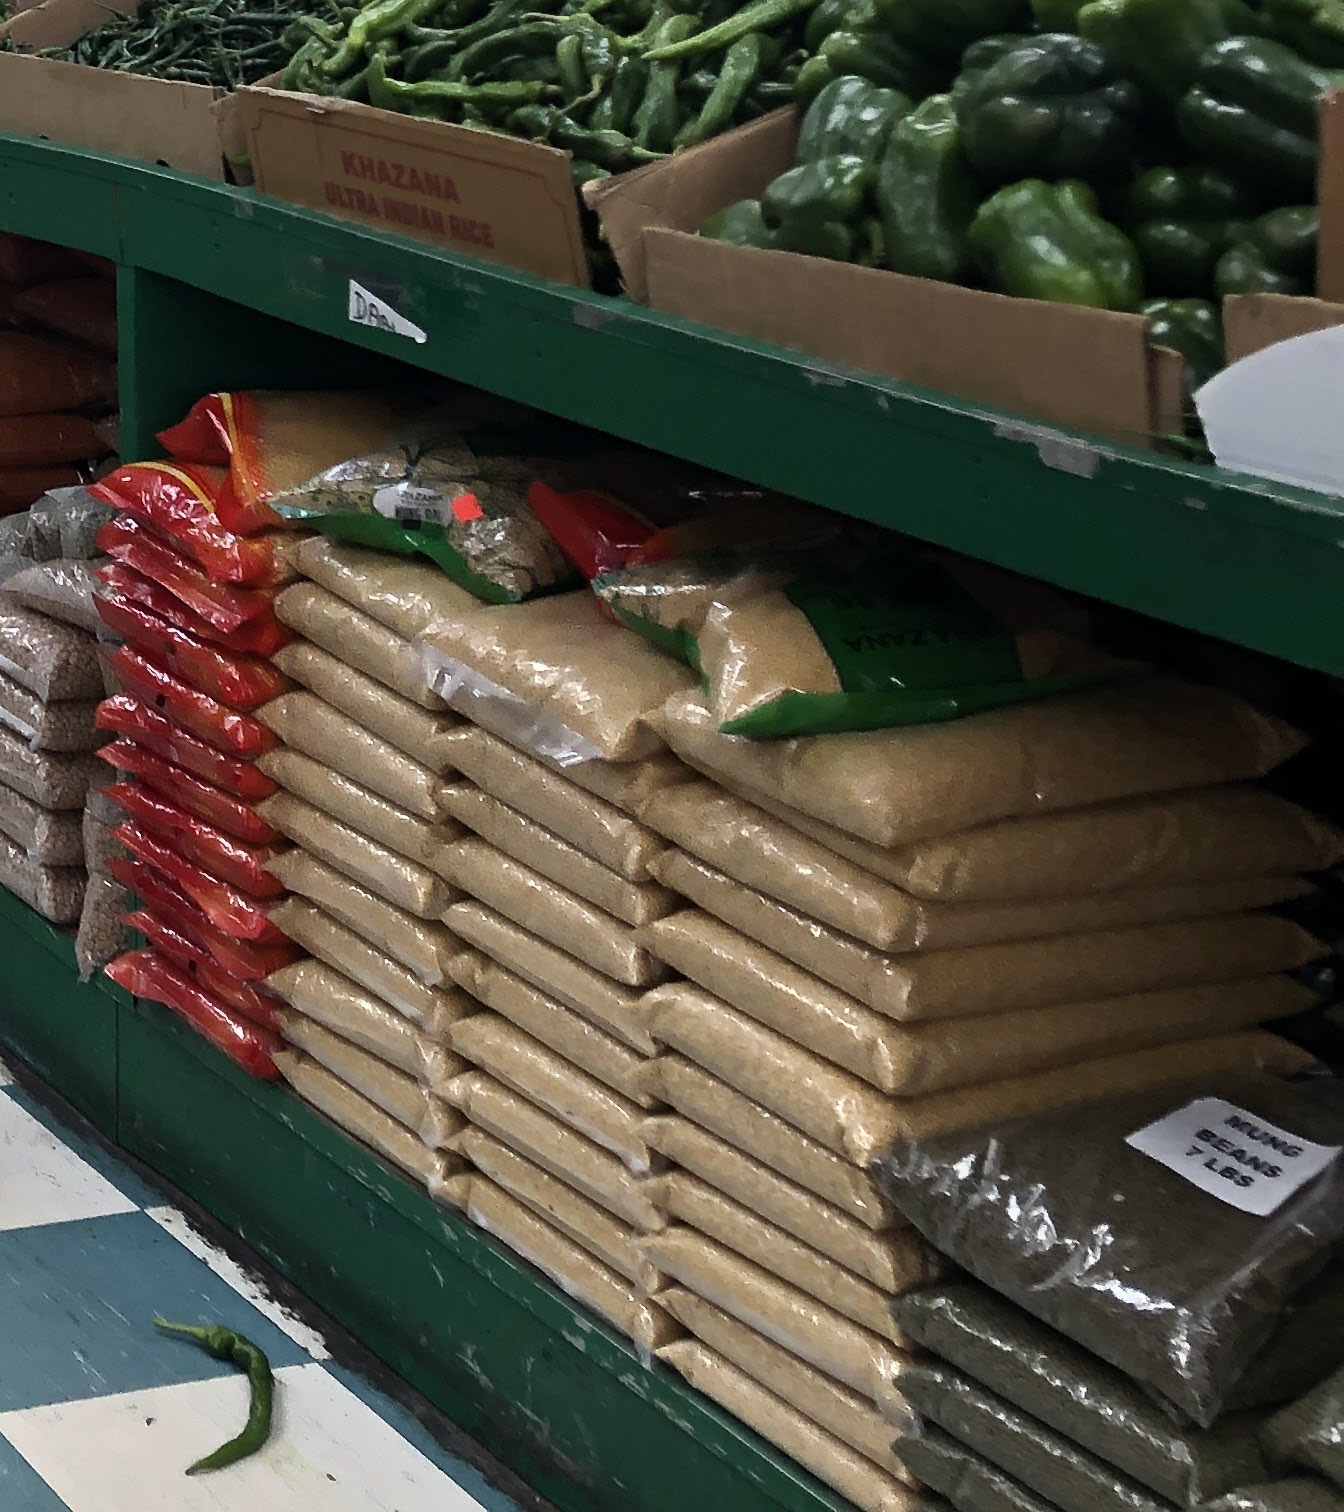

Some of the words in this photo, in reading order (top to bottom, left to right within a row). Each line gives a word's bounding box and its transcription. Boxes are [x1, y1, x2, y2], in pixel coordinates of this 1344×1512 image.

[341, 150, 461, 204] KHAZANA
[324, 181, 379, 218] ULTRA
[382, 197, 446, 235] INDIAN
[448, 214, 496, 250] RICE
[1195, 1128, 1284, 1178] BEANS
[1224, 1115, 1305, 1158] MUNG
[1185, 1144, 1205, 1157] 7
[1202, 1157, 1256, 1188] LBS
